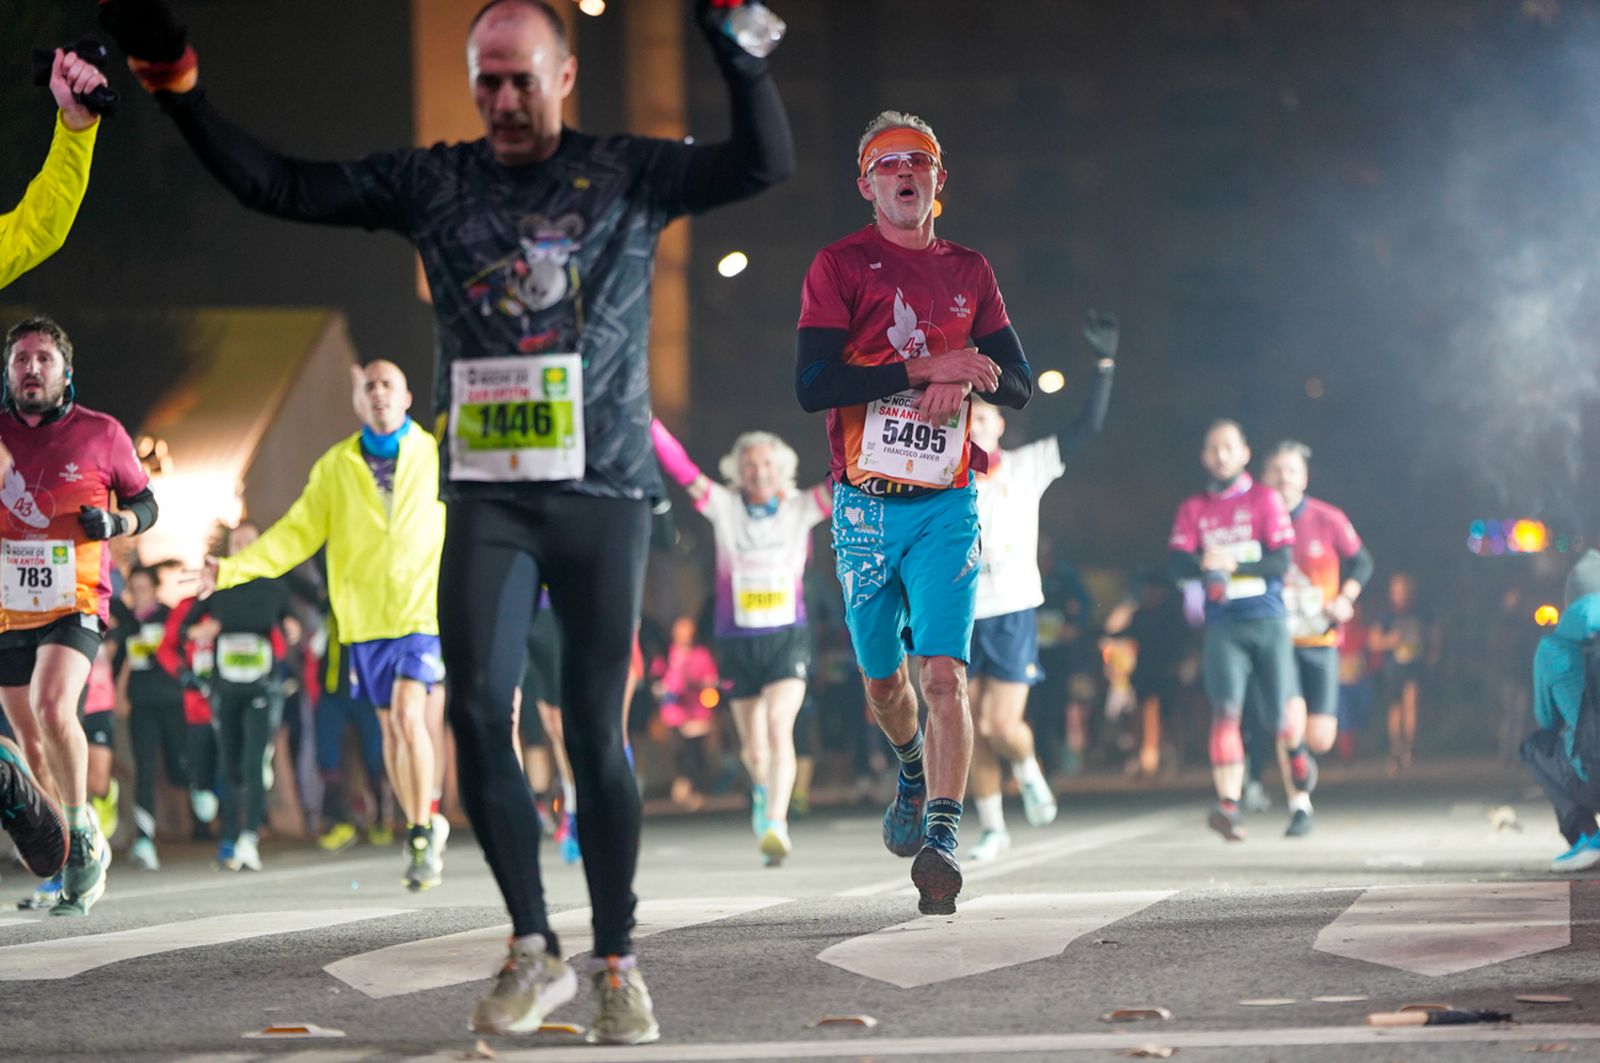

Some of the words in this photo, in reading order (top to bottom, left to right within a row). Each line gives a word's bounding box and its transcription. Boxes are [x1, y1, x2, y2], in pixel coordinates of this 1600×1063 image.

[480, 403, 553, 438] 1446
[879, 406, 899, 417] SAN
[900, 409, 923, 421] ANT
[882, 418, 947, 454] 5495
[883, 446, 918, 458] FRANCISCO
[919, 452, 941, 463] JAVIER
[13, 497, 34, 518] 43
[17, 566, 53, 588] 783
